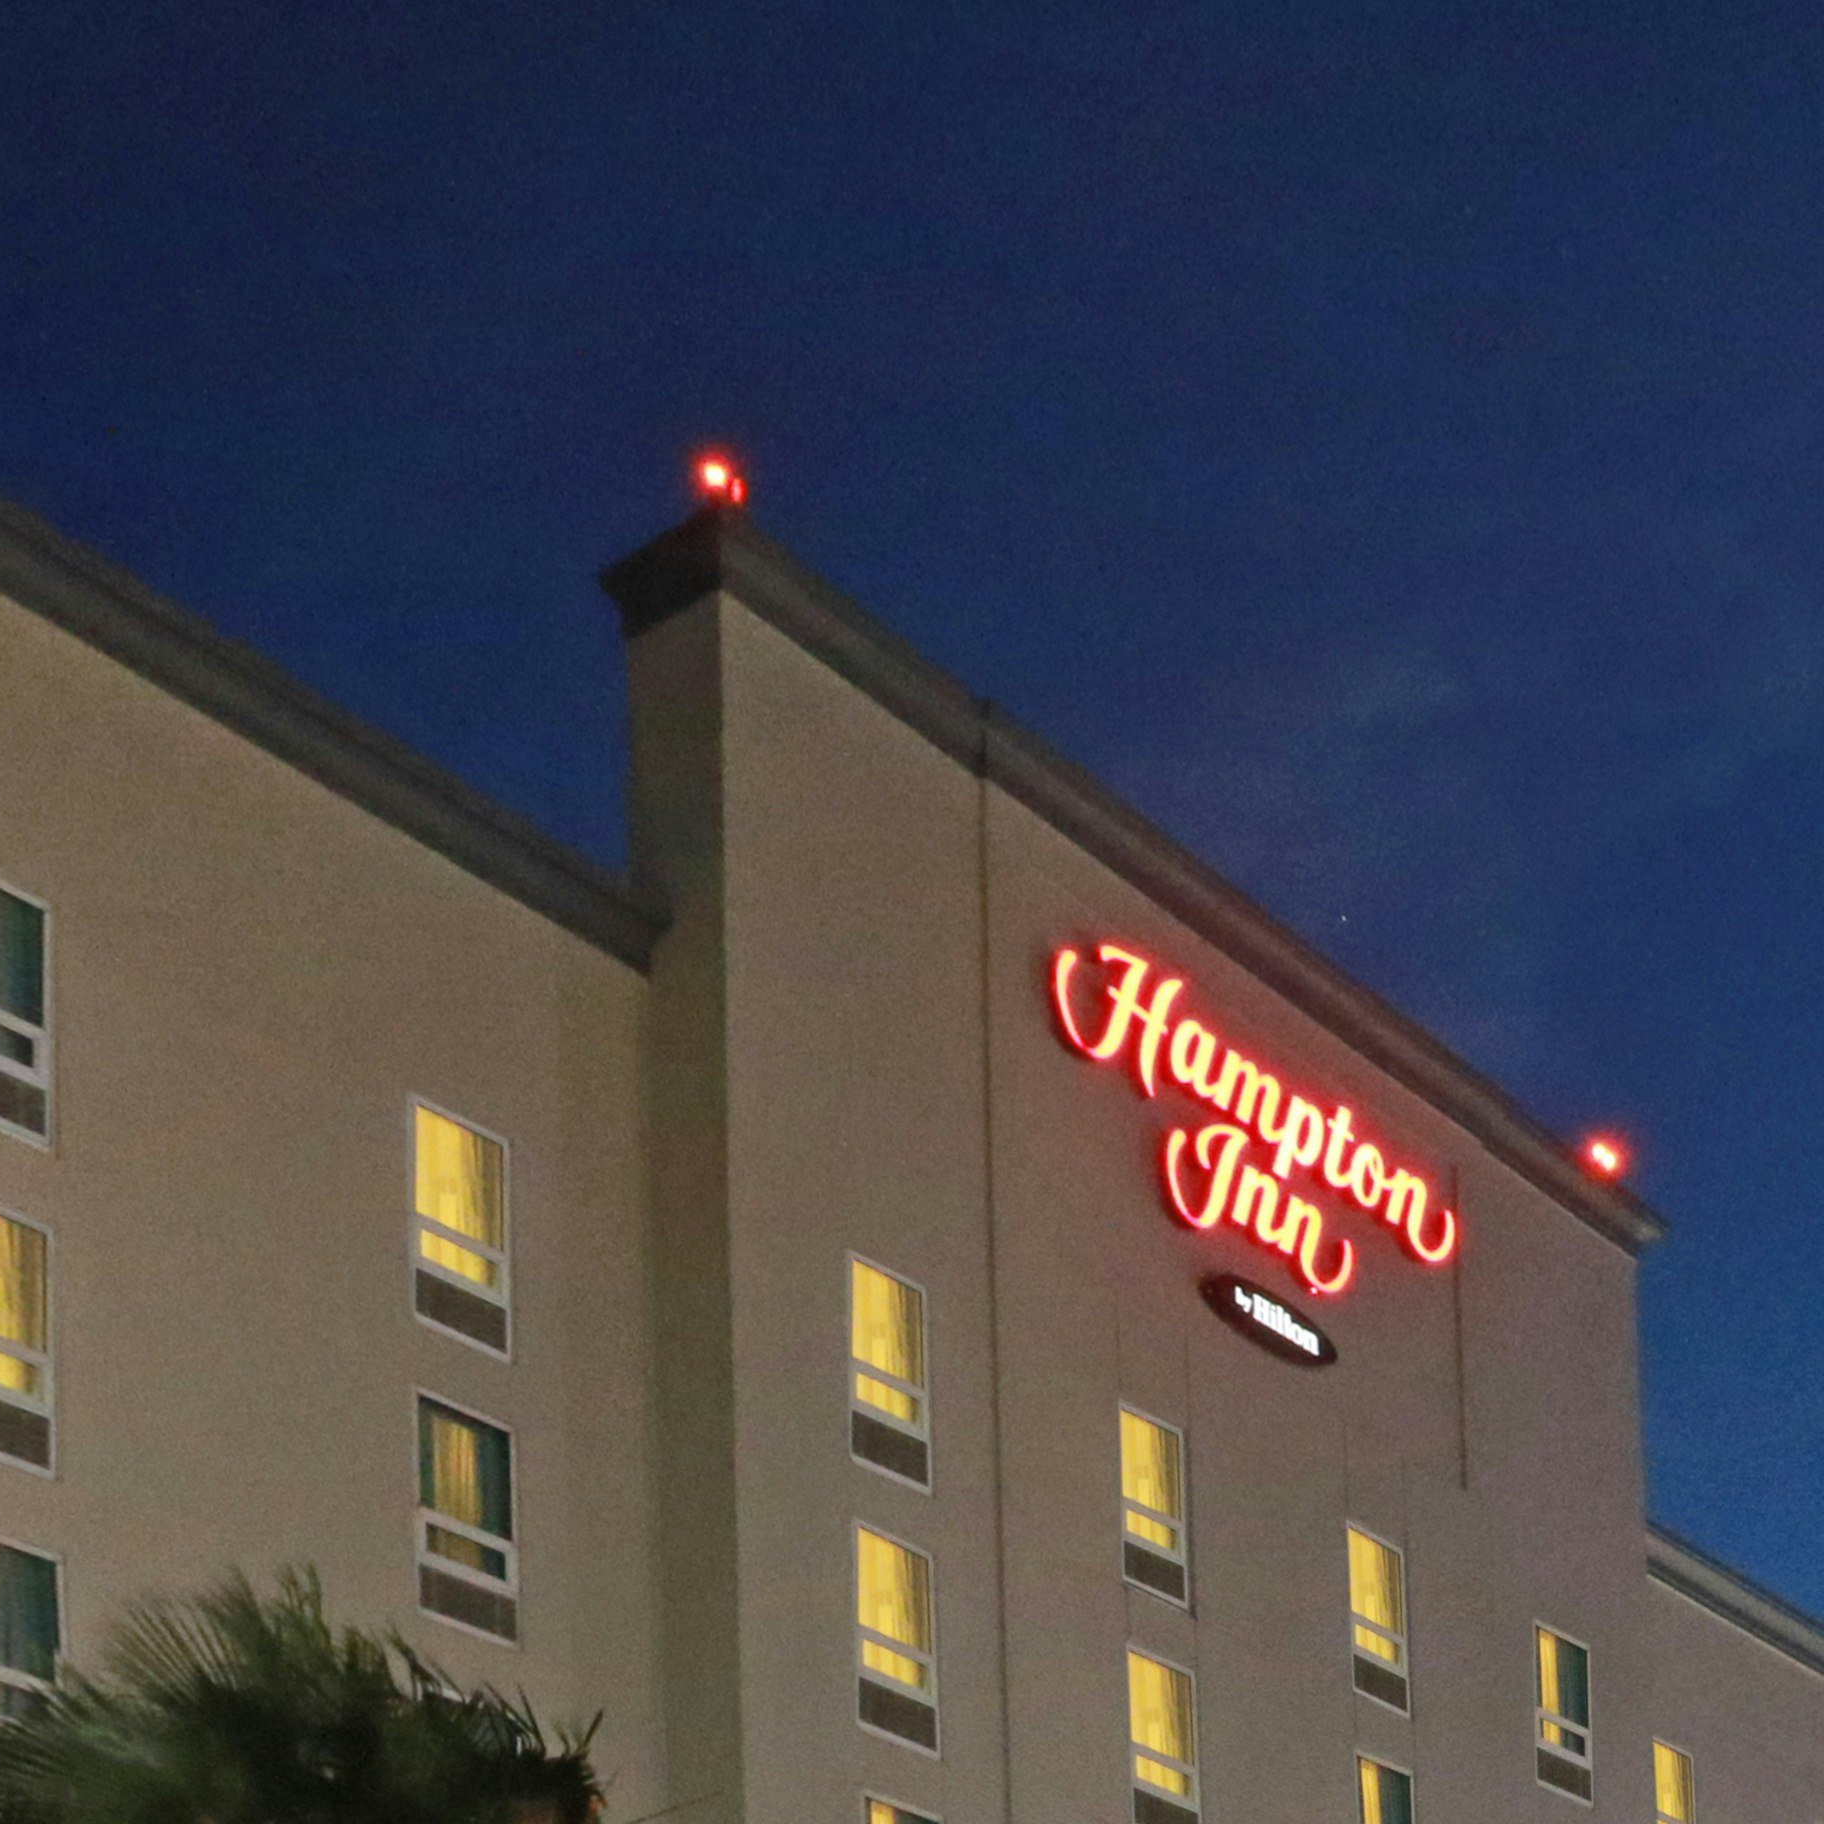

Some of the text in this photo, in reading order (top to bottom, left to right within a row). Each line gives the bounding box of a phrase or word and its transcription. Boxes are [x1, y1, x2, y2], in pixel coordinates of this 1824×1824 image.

[1054, 944, 1456, 1263] Hampton
[1165, 1123, 1353, 1294] Inn
[1251, 1292, 1320, 1357] Hilton
